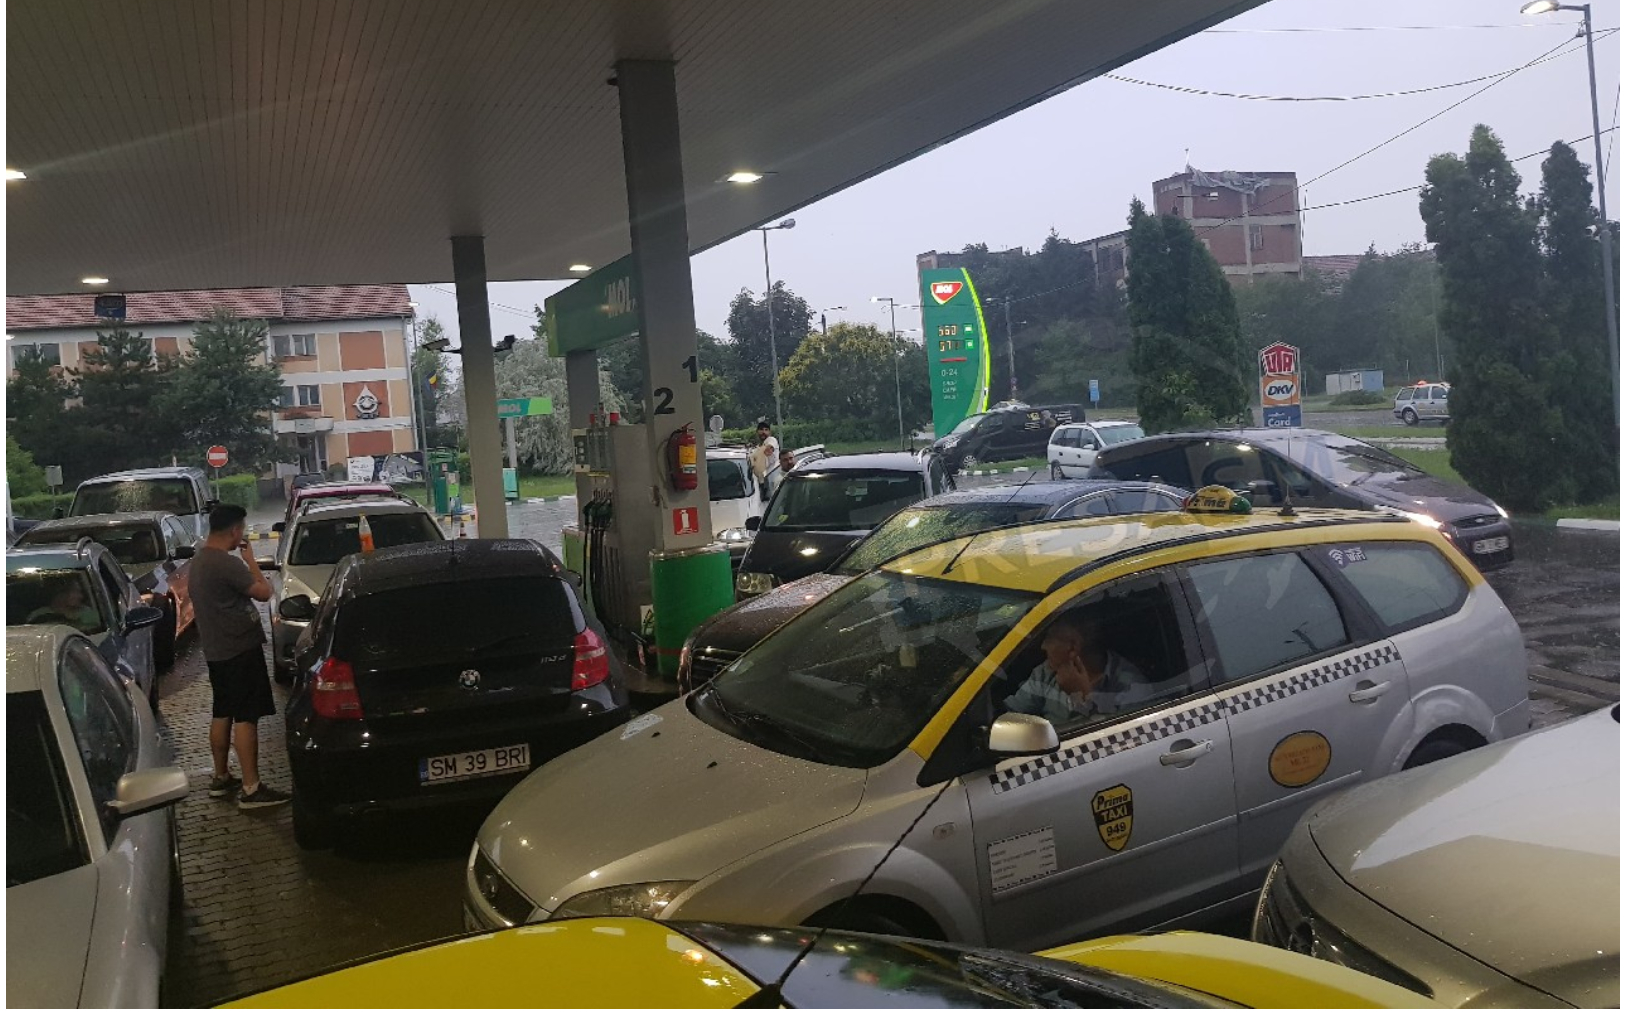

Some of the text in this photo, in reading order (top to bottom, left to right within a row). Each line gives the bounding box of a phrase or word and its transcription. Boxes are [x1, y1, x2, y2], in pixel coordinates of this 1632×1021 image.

[681, 355, 698, 383] 1
[653, 387, 676, 415] 2
[1267, 384, 1294, 396] DKV
[431, 746, 526, 777] SM 39 BRI
[1101, 804, 1128, 822] TAXI
